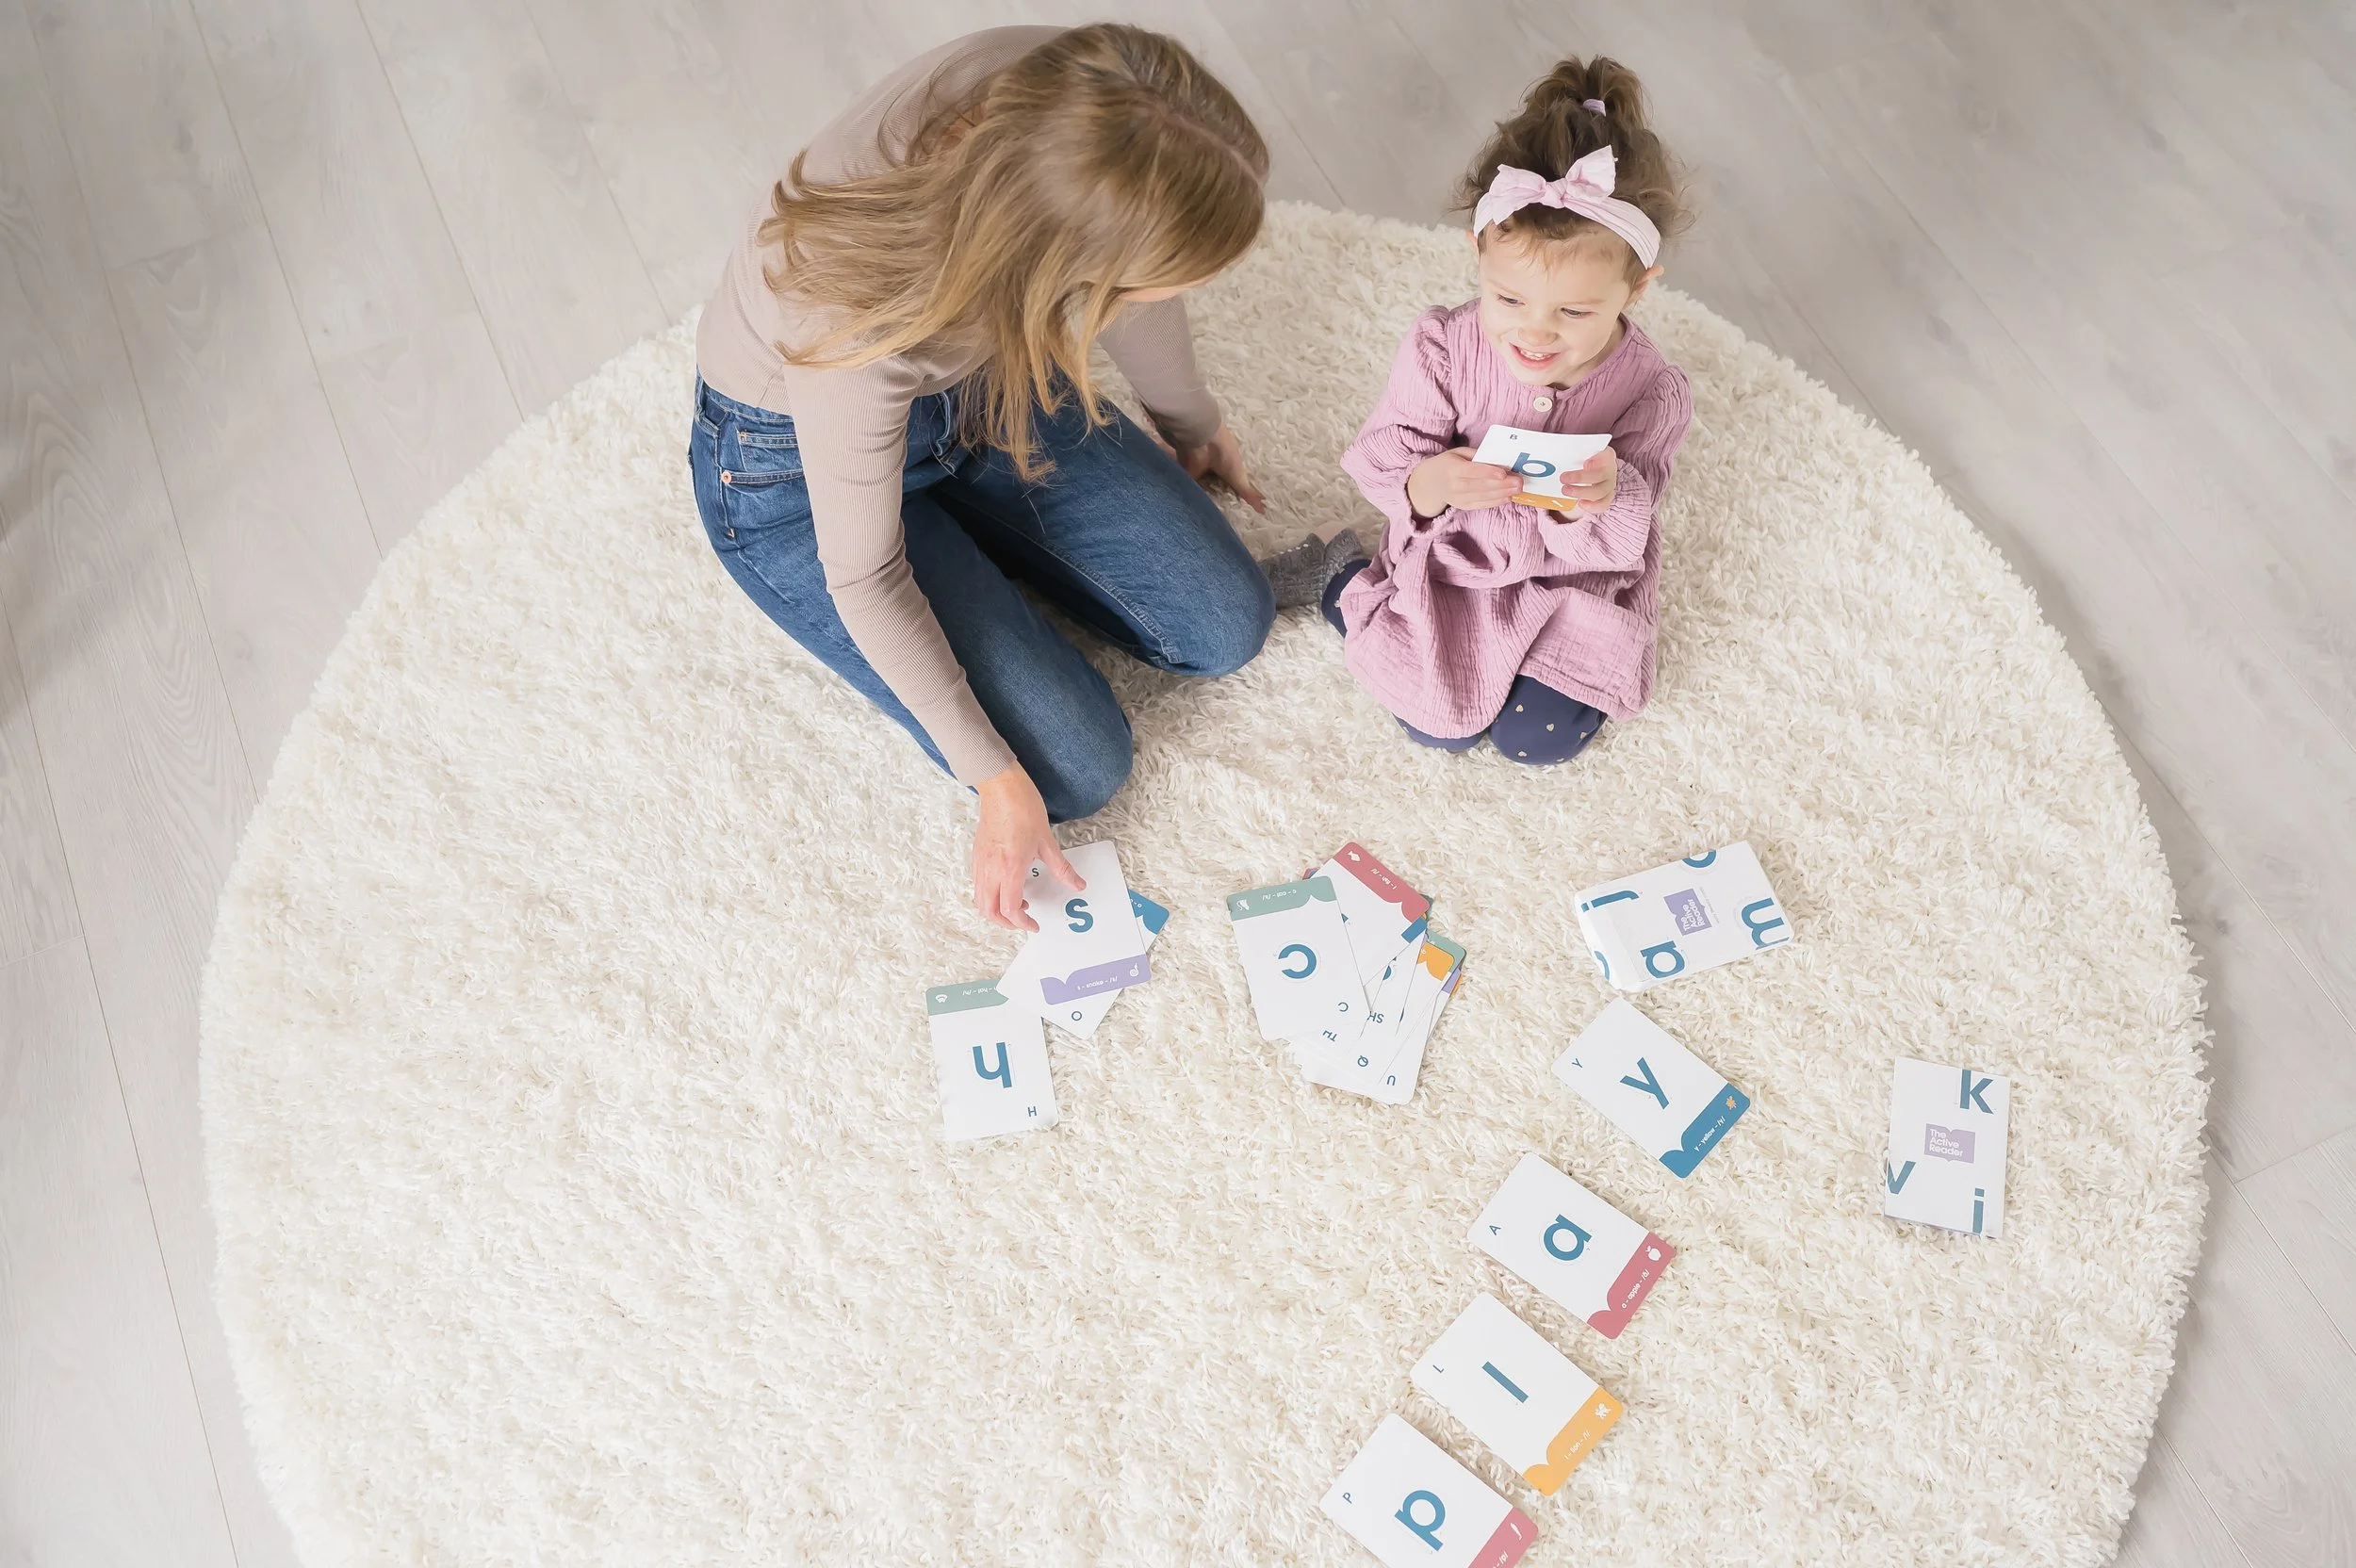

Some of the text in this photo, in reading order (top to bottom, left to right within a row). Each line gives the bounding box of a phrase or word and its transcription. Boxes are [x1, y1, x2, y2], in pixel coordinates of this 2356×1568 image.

[1511, 451, 1557, 479] b
[1031, 867, 1039, 878] S
[1064, 898, 1094, 933] s
[1682, 905, 1699, 927] Active
[1687, 899, 1706, 926] Reader
[1680, 917, 1692, 932] The
[1278, 943, 1317, 980] c
[1639, 939, 1687, 979] a
[1338, 1002, 1350, 1013] C
[1071, 1010, 1083, 1021] O
[1322, 1030, 1337, 1042] TH
[972, 1041, 1013, 1089] h
[1357, 1054, 1369, 1068] Q
[1571, 1057, 1583, 1069] Y
[1386, 1074, 1397, 1086] U
[1619, 1056, 1670, 1110] y
[1959, 1069, 1994, 1115] k
[1027, 1105, 1038, 1118] H
[1700, 1127, 1715, 1145] yellow
[1930, 1128, 1947, 1139] The
[1929, 1136, 1959, 1149] Active
[1929, 1143, 1963, 1157] Reader
[1488, 1225, 1502, 1236] A
[1543, 1214, 1593, 1262] a
[1628, 1283, 1641, 1299] apple
[1432, 1364, 1445, 1375] L
[1570, 1442, 1581, 1453] lion
[1342, 1492, 1352, 1505] P
[1394, 1490, 1446, 1552] p
